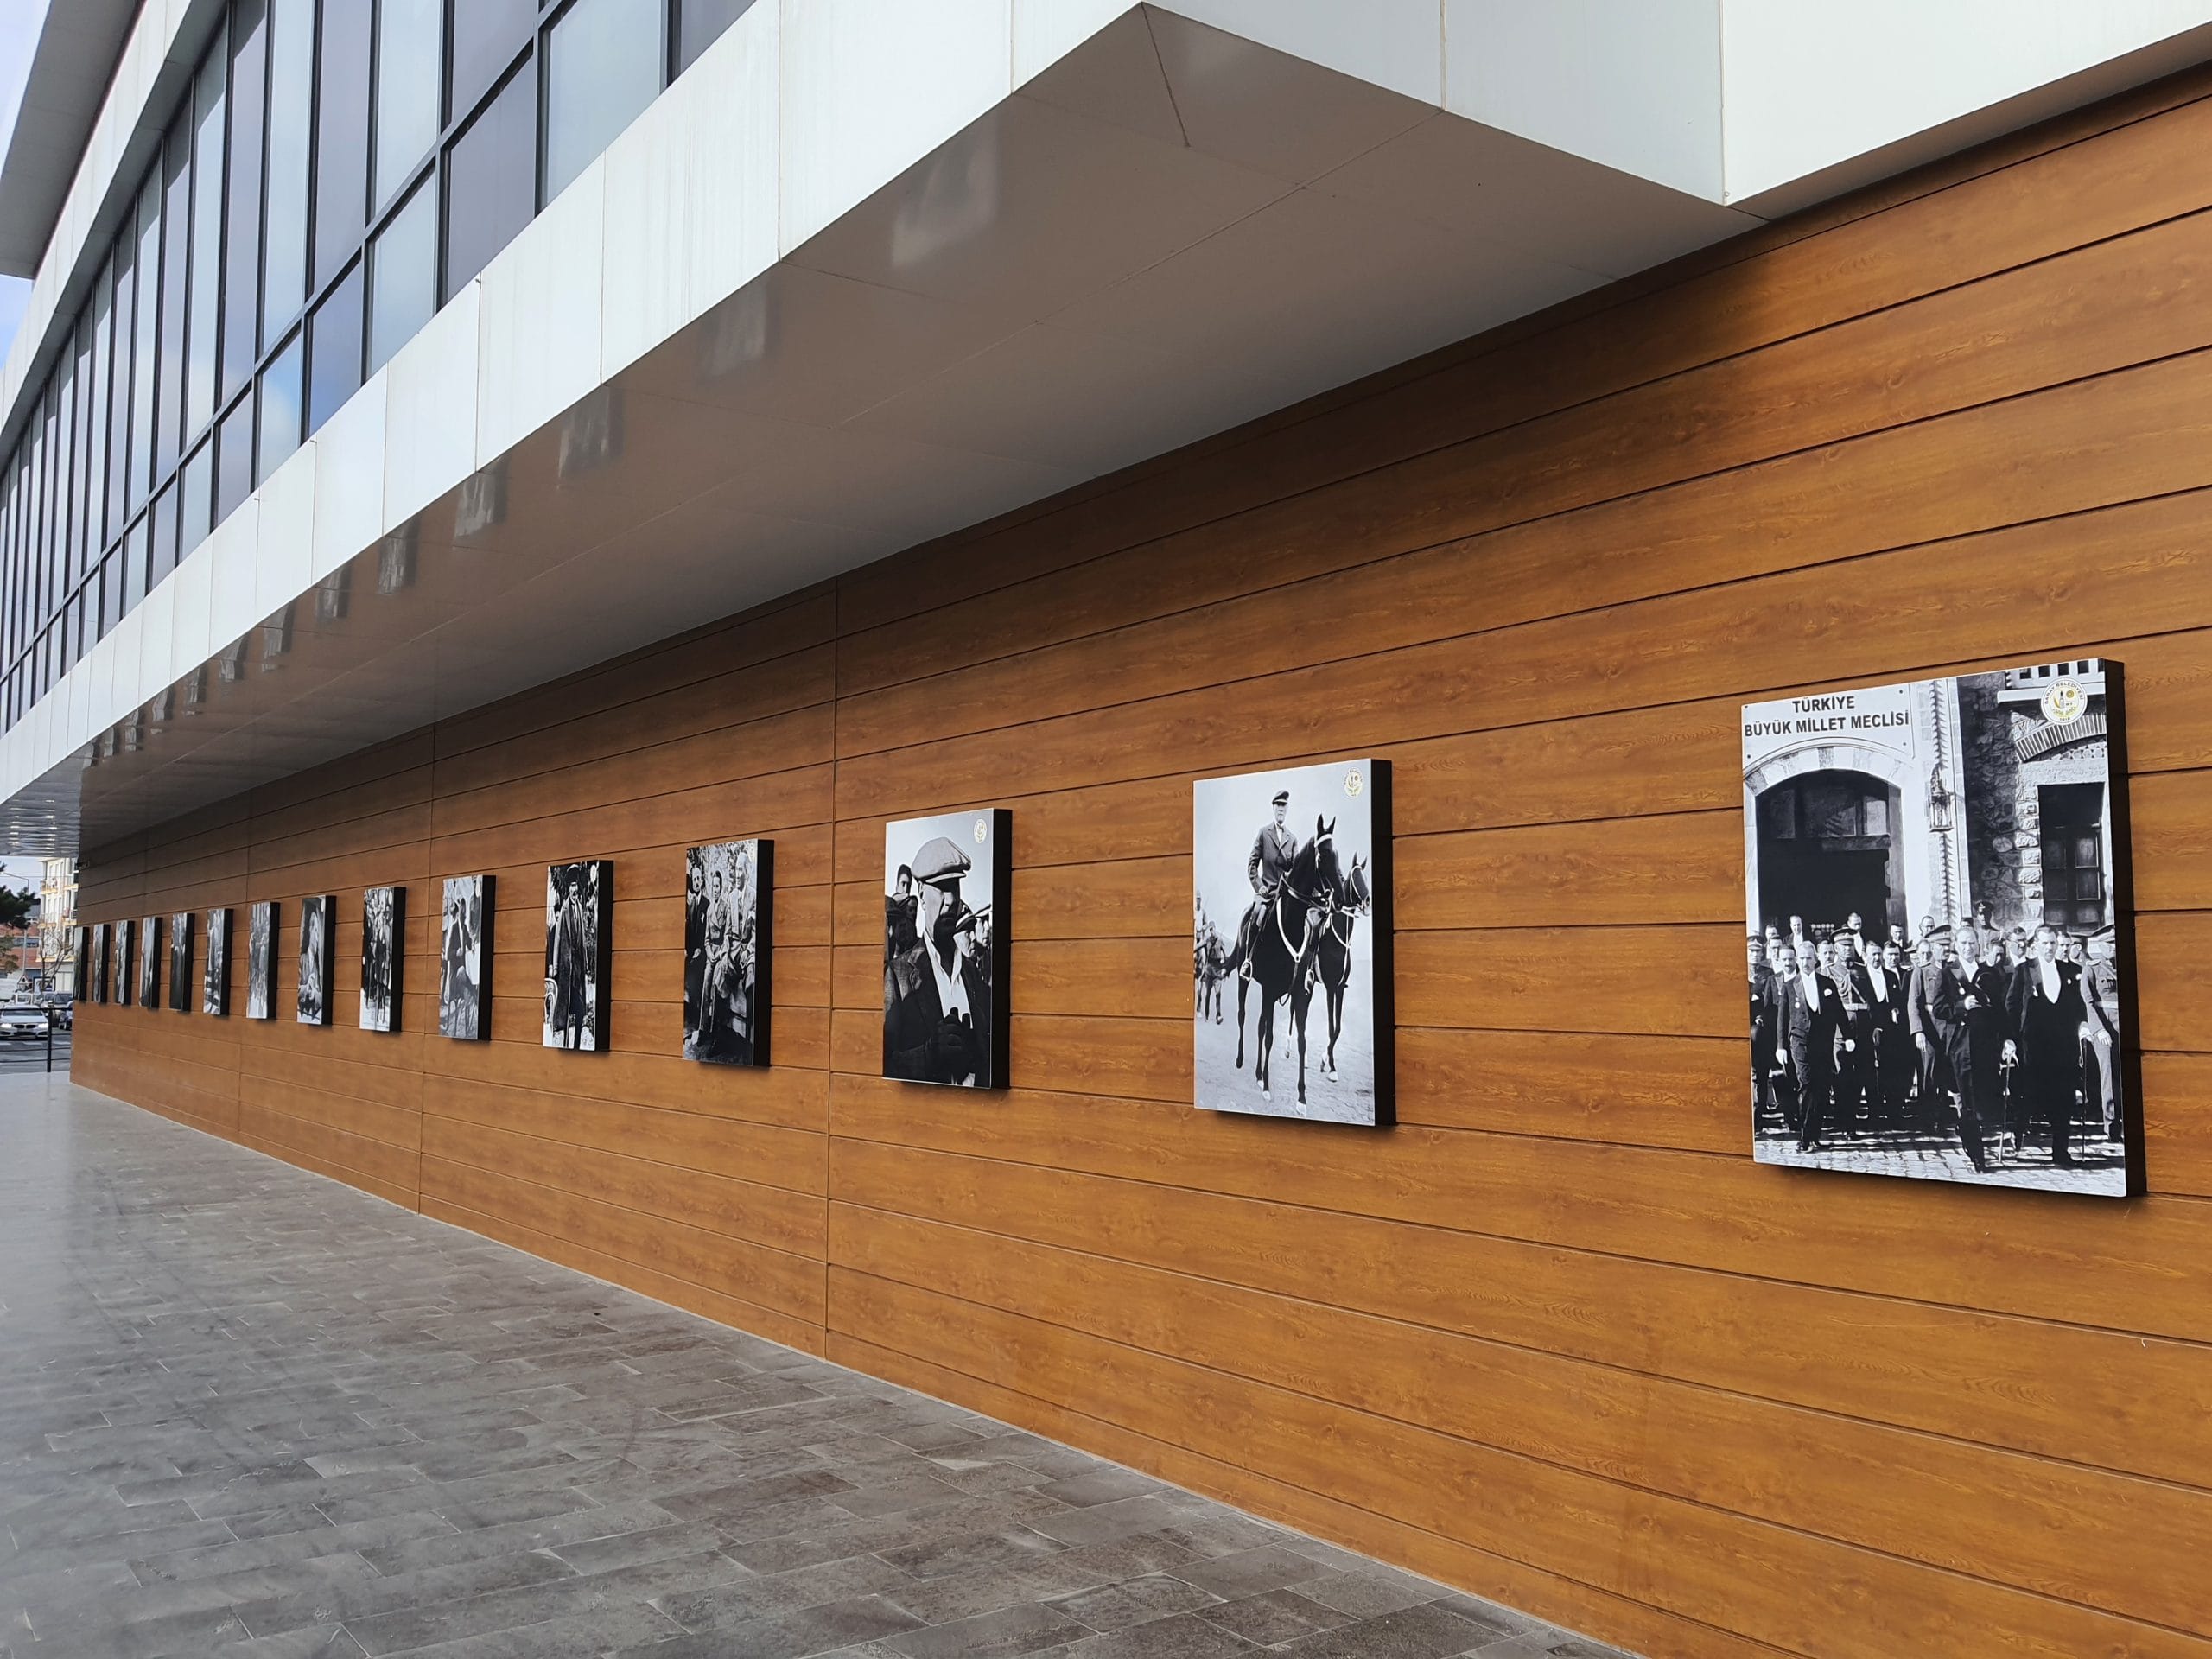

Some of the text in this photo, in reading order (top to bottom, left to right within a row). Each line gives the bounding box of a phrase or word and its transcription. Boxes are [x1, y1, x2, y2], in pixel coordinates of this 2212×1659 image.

[1792, 696, 1855, 713] TÜRKİYE
[1745, 710, 1909, 736] BÜYÜK MİLLET MECLİSİ
